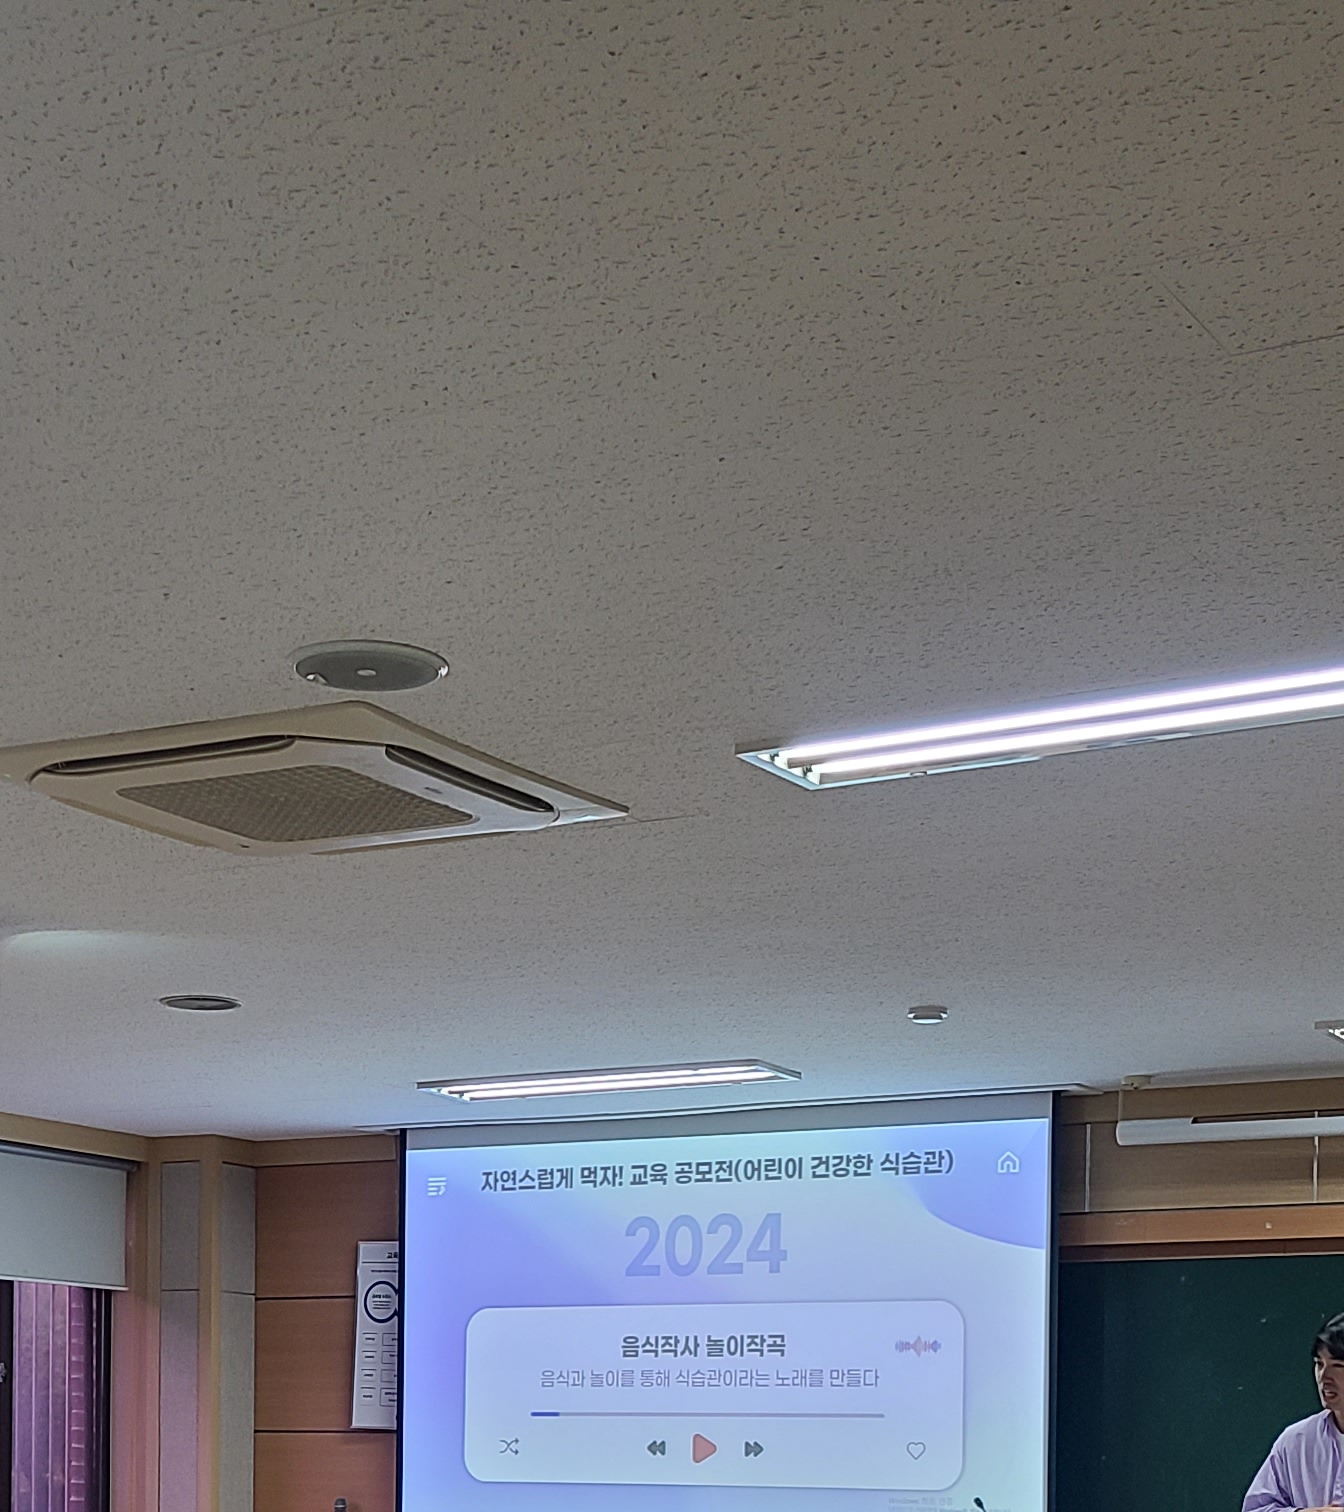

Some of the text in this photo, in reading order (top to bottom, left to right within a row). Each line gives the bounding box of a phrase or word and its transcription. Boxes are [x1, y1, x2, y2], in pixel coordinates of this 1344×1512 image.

[481, 1149, 954, 1192] 자연스럽게 먹자! 교육 공모전(어린이 건강한 식습관)
[625, 1213, 787, 1277] 2024
[621, 1334, 786, 1358] 음식작사 놀이작곡
[540, 1368, 879, 1388] 음식과 놀이를 통해 식습관이라는 노래를 만들다
